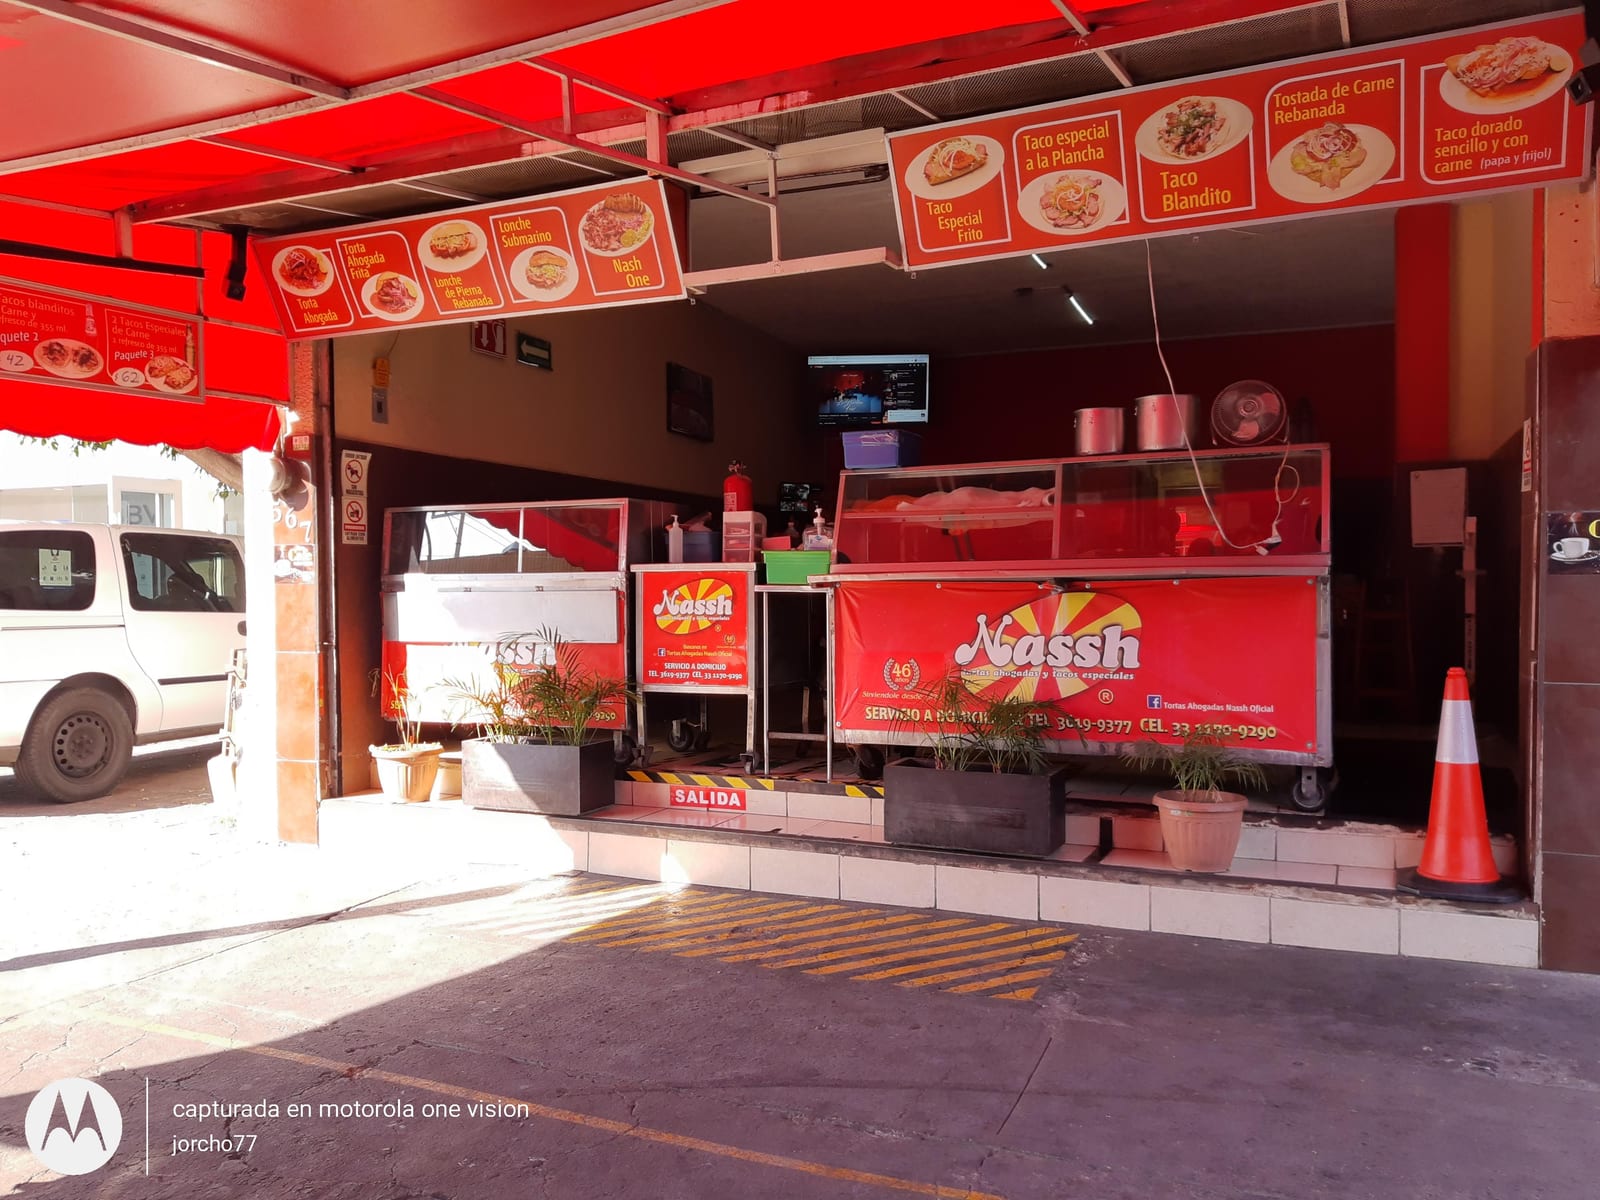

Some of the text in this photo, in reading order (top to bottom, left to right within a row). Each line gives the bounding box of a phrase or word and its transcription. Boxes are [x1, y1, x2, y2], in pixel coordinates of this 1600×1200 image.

[1274, 77, 1394, 108] Tostada de Carne
[1274, 101, 1346, 125] Rebanada
[1023, 121, 1110, 152] Taco especial
[1435, 116, 1523, 142] Taco dorado
[1434, 133, 1529, 158] sencillo y con
[1026, 144, 1105, 171] a la Plancha
[1434, 147, 1552, 174] carne (papa y frijol)
[1160, 170, 1198, 190] Taco
[1162, 188, 1232, 212] Blandito
[926, 201, 953, 216] Taco
[498, 217, 532, 234] Lonche
[938, 210, 983, 231] Especial
[502, 231, 552, 248] Submarino
[958, 227, 983, 243] Frito
[343, 242, 366, 256] Torta
[348, 252, 386, 268] Ahogada
[612, 256, 642, 273] Nash
[350, 268, 370, 280] Frita
[434, 274, 463, 288] Lonche
[626, 274, 650, 288] One
[445, 287, 456, 298] de
[2, 296, 74, 316] acos blanditos
[298, 298, 318, 310] Torta
[452, 294, 494, 309] Rebanada
[1, 305, 37, 320] Carne y
[304, 310, 338, 326] Ahogada
[1, 315, 26, 326] fresco
[28, 320, 38, 328] de
[112, 316, 186, 336] 2 Tacos Especiales
[0, 331, 39, 346] quete 2
[112, 325, 150, 340] de Carne
[6, 354, 24, 366] 42
[114, 350, 148, 362] Paquete
[653, 589, 733, 616] Nassh
[954, 613, 1140, 670] Nassh
[664, 662, 690, 670] SERVICIO
[892, 662, 912, 678] 46
[993, 669, 1040, 678] ahogadas
[1042, 671, 1049, 680] y
[1052, 670, 1078, 679] tacos
[1082, 671, 1134, 680] especiales
[1164, 702, 1186, 710] Tortas
[1188, 702, 1224, 712] Ahogadas
[1226, 704, 1248, 712] Nassh
[1250, 704, 1274, 714] Oficial
[924, 710, 933, 722] A
[1140, 718, 1168, 732] CEL.
[1172, 722, 1190, 736] 33
[675, 789, 741, 807] SALIDA
